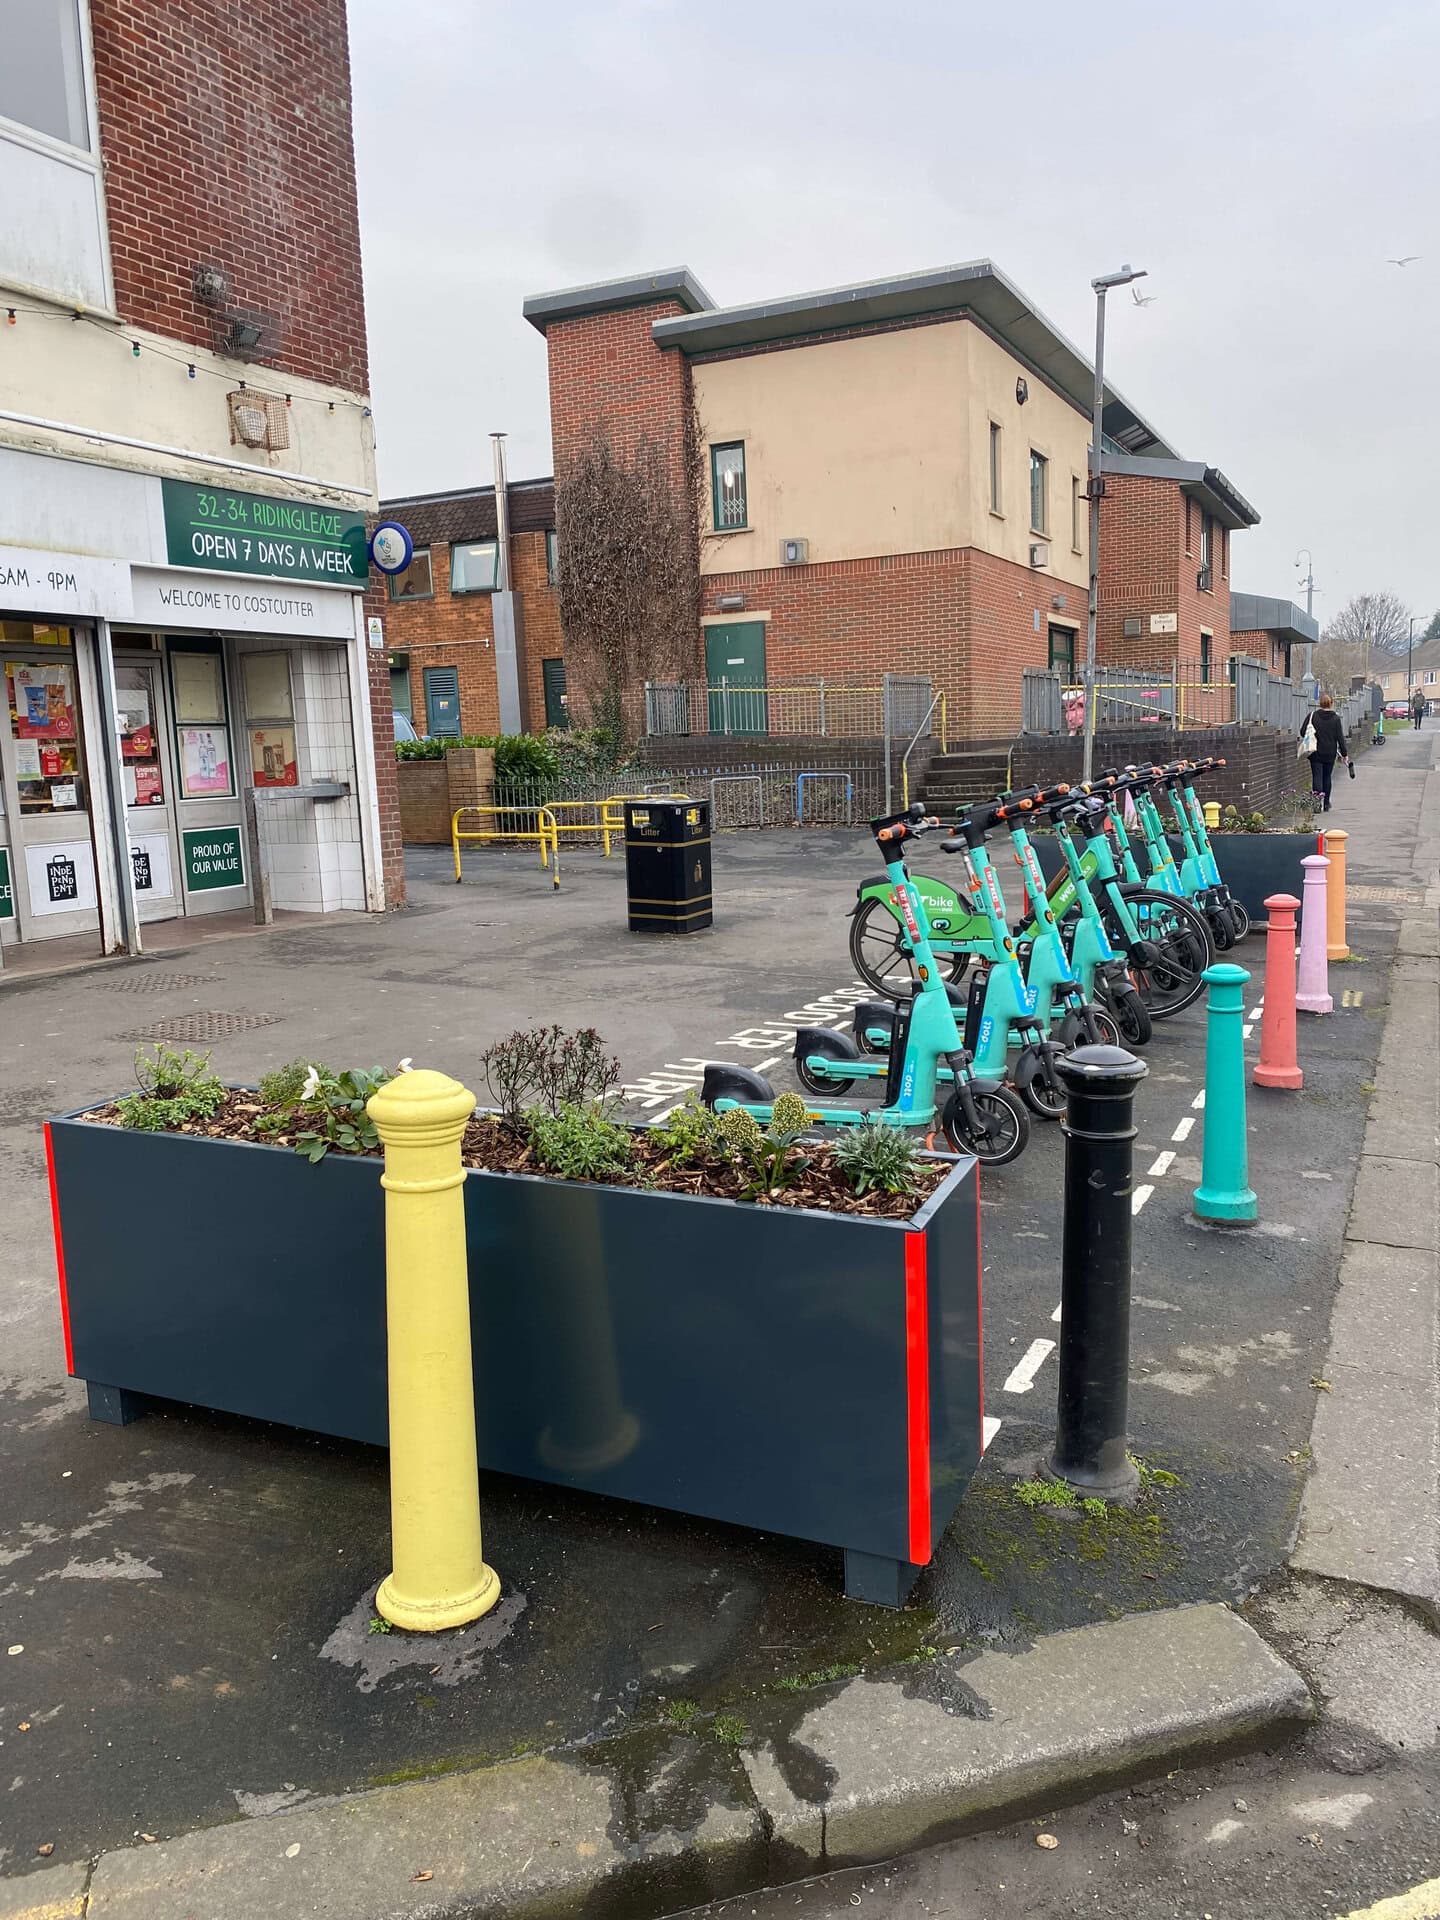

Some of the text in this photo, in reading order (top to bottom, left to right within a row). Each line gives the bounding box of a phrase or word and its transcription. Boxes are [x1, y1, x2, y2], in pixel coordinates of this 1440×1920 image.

[197, 493, 342, 537] 32-34 RIDINGLEAZE
[192, 532, 237, 560] OPEN
[242, 539, 251, 561] 7
[258, 541, 295, 567] DAYS
[300, 547, 309, 569] A
[312, 548, 354, 574] WEEK
[48, 571, 77, 593] 9PM
[159, 587, 314, 617] WELCOME TO COSTCUTTER
[192, 842, 234, 858] PROUD OF
[50, 865, 72, 876] INDE
[192, 857, 239, 874] OUR VALUE
[981, 1020, 993, 1043] dott
[903, 1074, 912, 1097] dott
